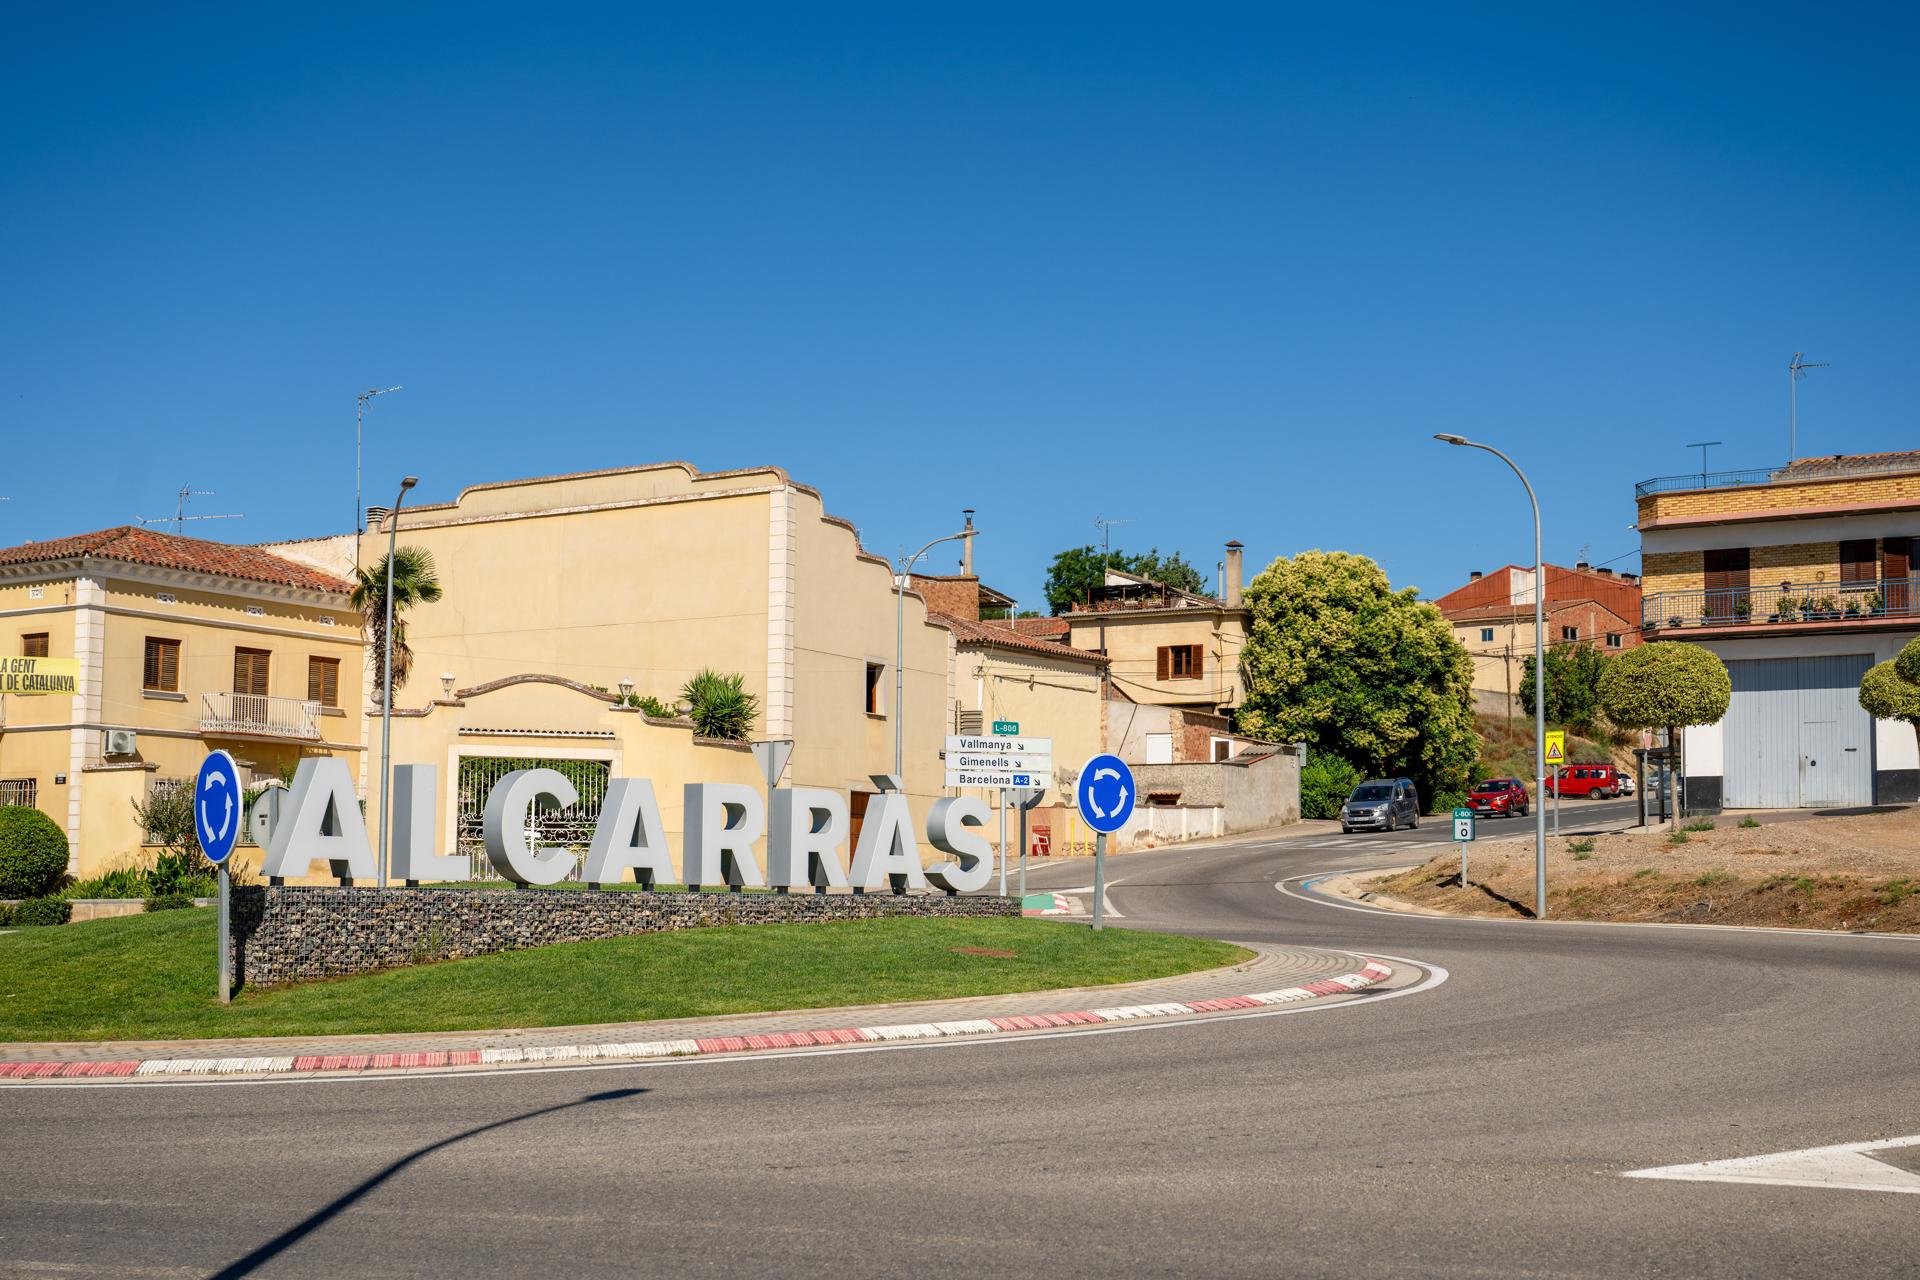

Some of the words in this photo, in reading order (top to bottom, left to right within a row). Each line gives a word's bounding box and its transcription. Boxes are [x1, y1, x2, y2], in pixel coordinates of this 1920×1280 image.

[0, 658, 7, 673] A
[11, 658, 37, 673] GENT
[7, 674, 19, 690] DE
[22, 673, 75, 692] CATALUNYA
[995, 724, 1017, 732] L-800
[960, 739, 1012, 751] Vallmanya
[960, 757, 1009, 767] Gimenells
[960, 774, 1011, 785] Barcelona
[1014, 776, 1029, 784] A-2
[259, 756, 994, 893] ALCARRÀS
[1460, 828, 1468, 837] 0
